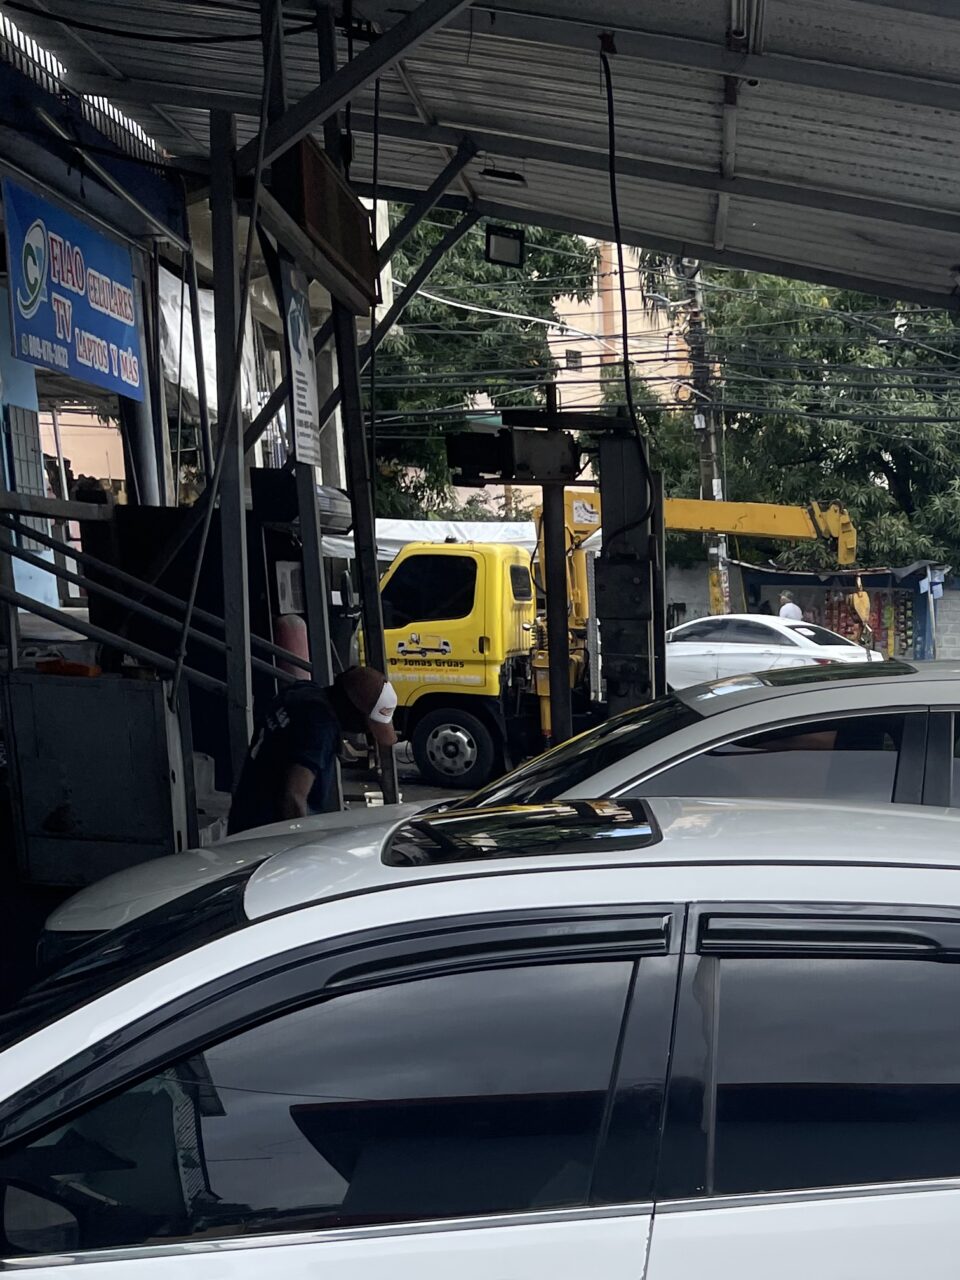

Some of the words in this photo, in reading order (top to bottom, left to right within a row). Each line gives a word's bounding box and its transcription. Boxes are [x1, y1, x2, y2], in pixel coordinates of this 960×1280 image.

[88, 269, 134, 325] CELULARES
[53, 294, 72, 342] TV
[110, 344, 118, 377] Y
[404, 659, 432, 667] Jonas
